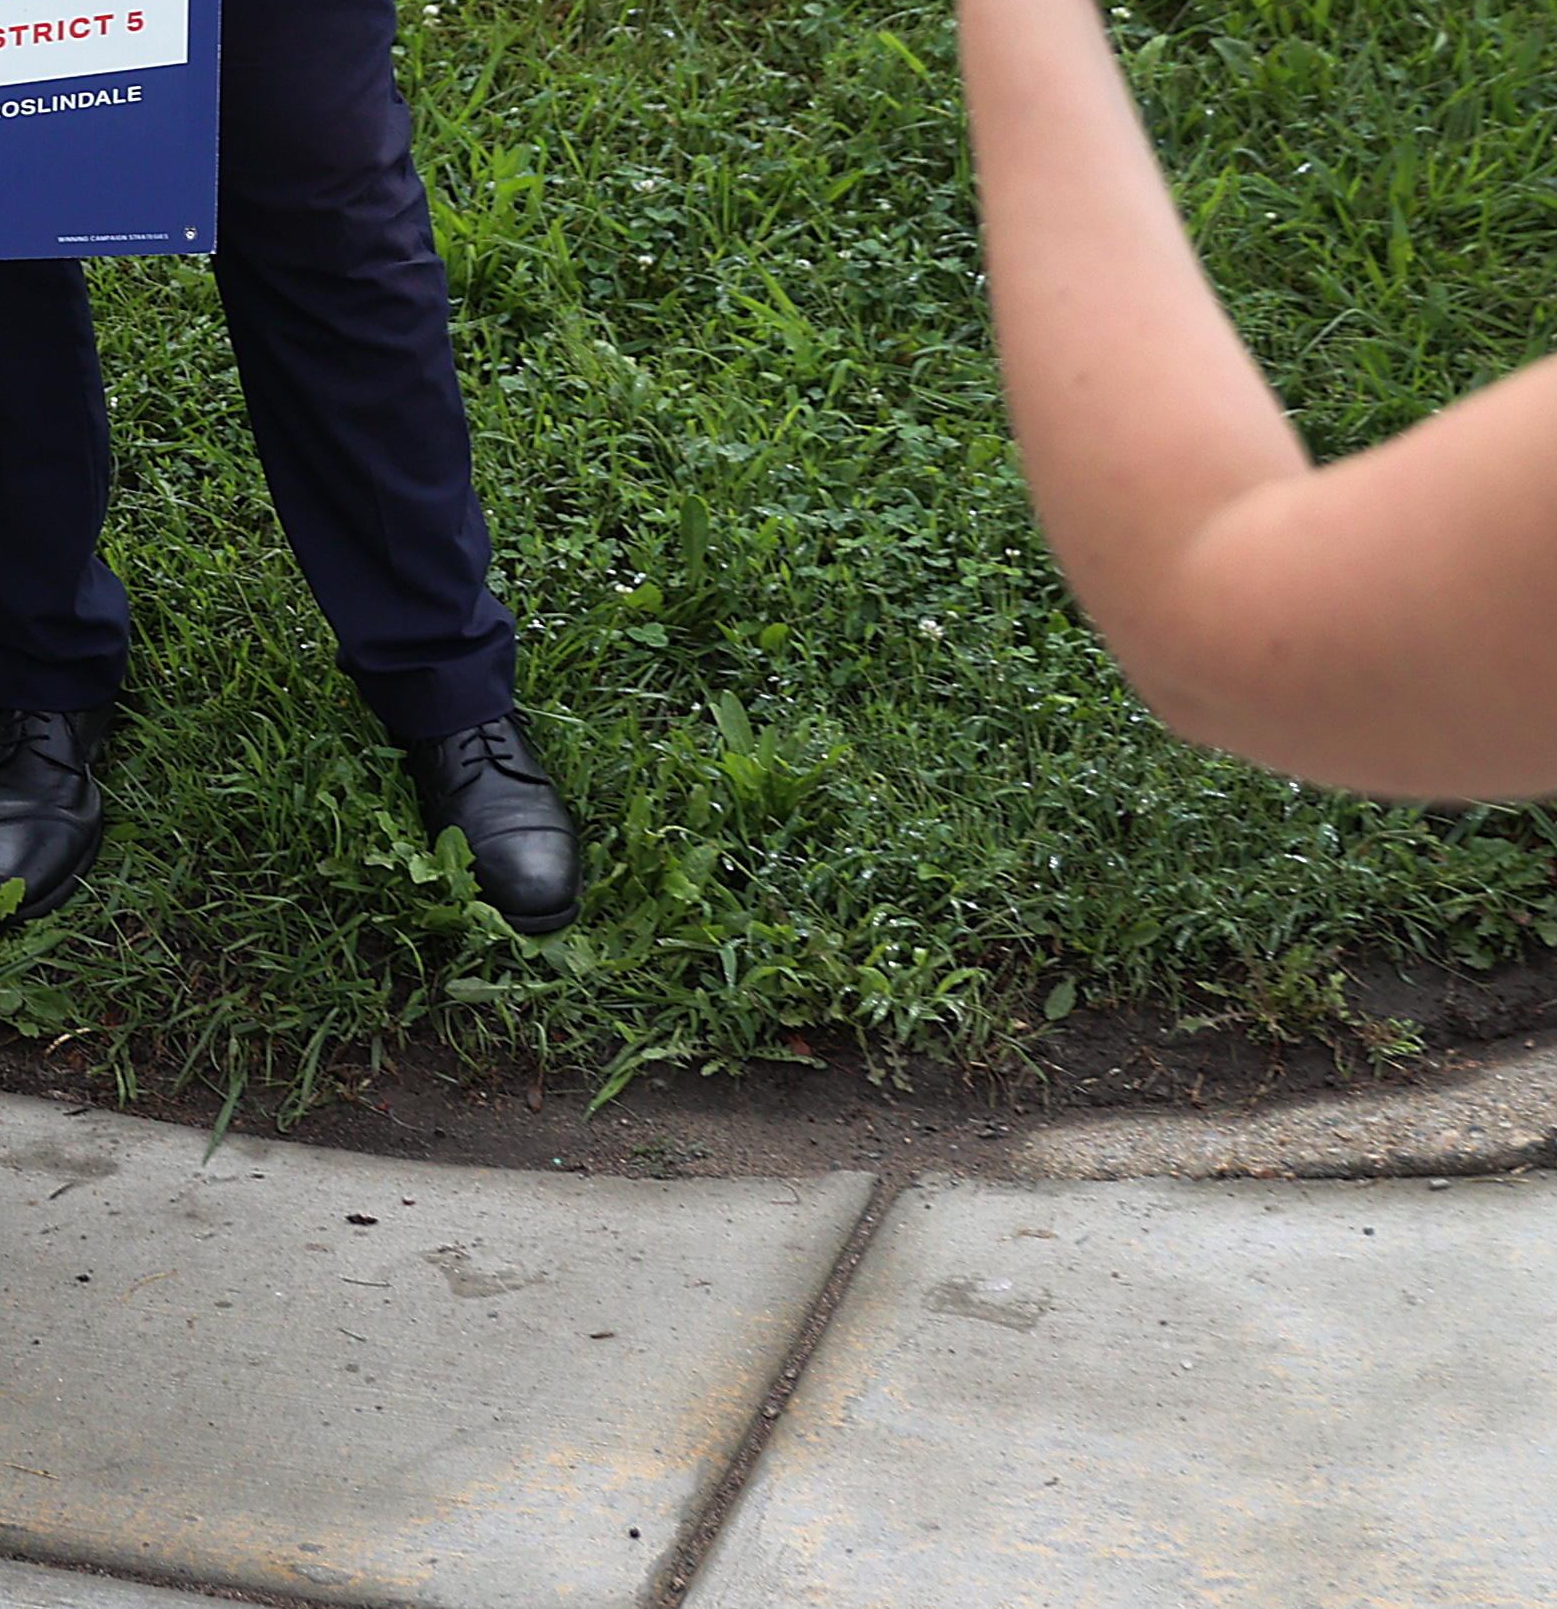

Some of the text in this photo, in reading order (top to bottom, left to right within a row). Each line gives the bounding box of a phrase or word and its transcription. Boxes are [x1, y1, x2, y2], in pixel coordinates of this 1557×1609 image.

[127, 10, 145, 32] 5
[57, 233, 169, 243] WINNING CAMPAIGN STRATEGIES
